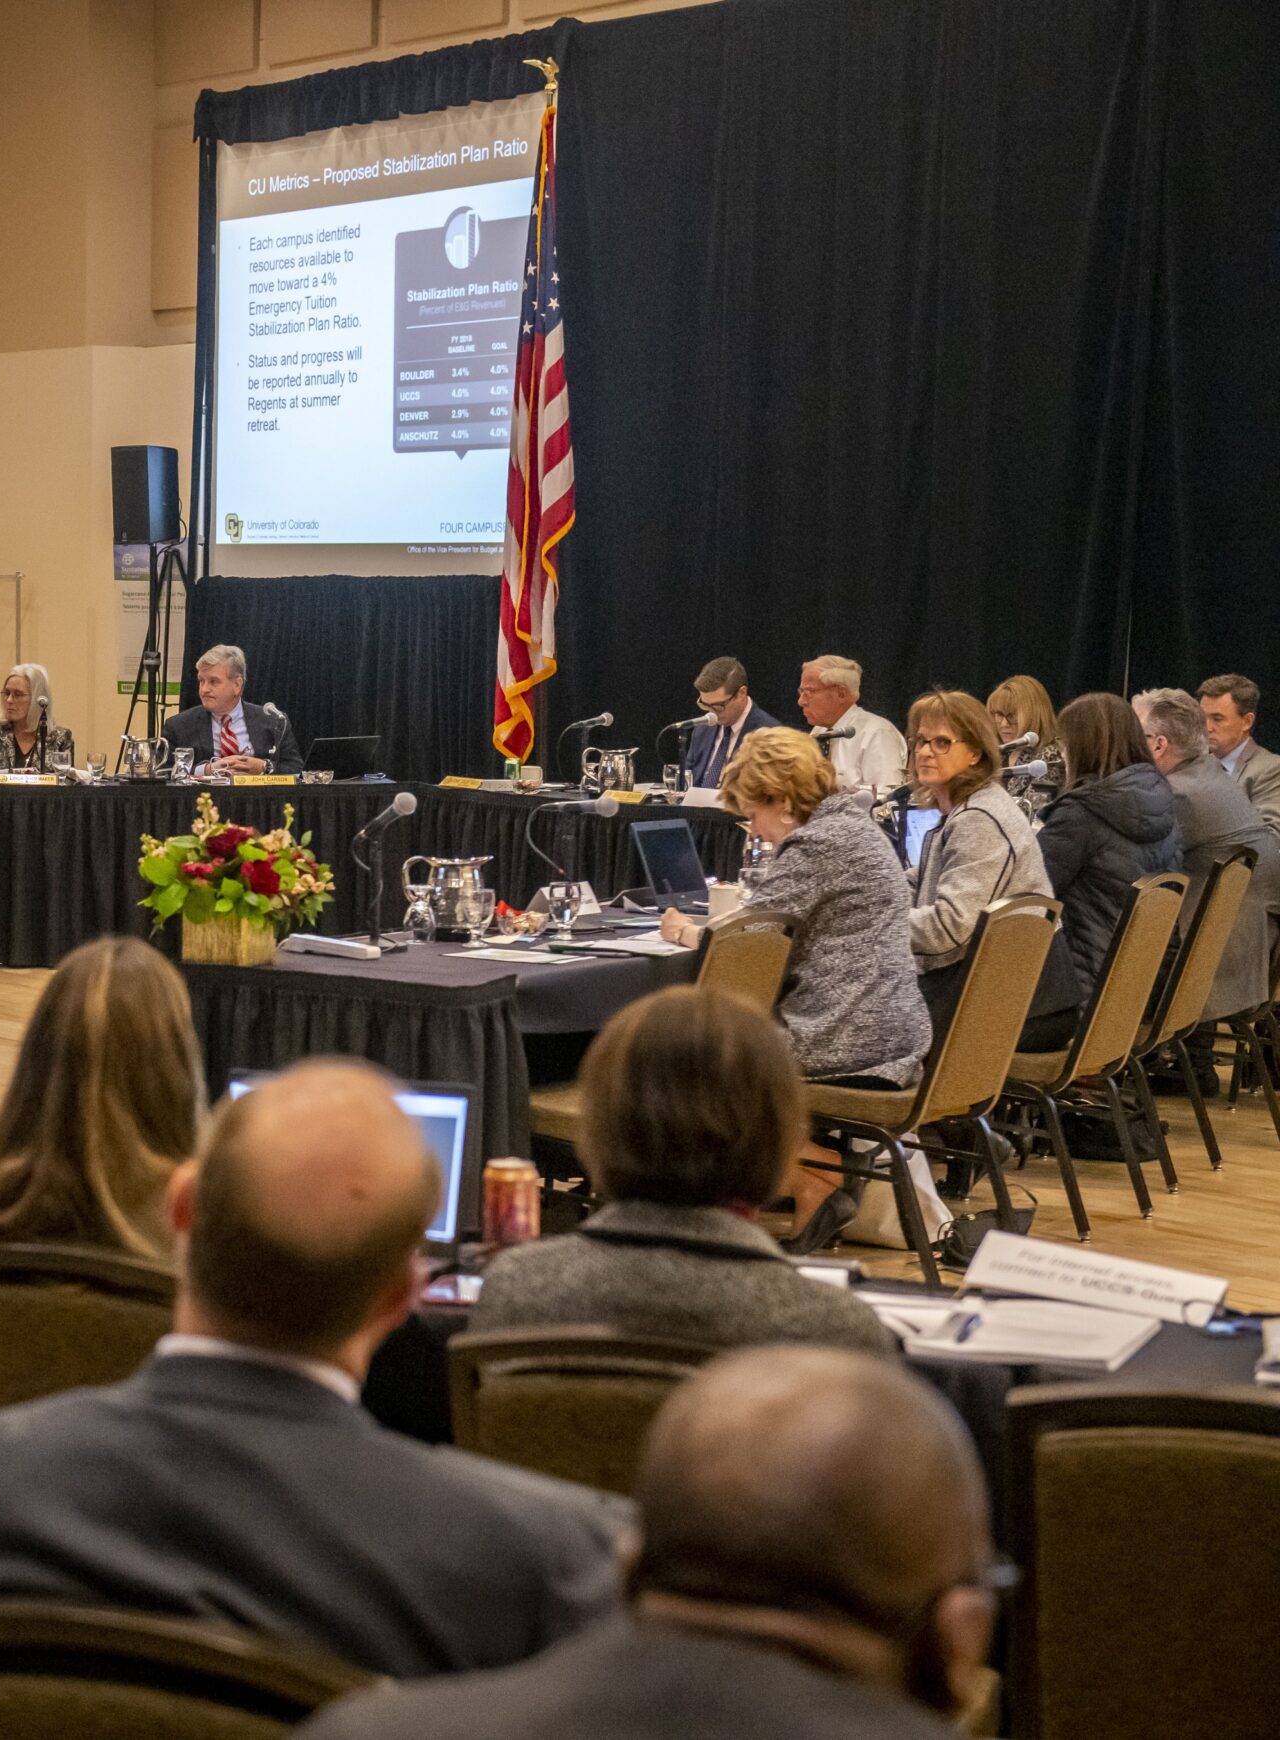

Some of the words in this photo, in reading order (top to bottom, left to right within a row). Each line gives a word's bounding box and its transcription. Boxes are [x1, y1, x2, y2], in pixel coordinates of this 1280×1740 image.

[248, 177, 266, 196] CU
[269, 173, 310, 193] Metrics
[323, 161, 380, 186] Proposed
[383, 150, 457, 176] Stabilization
[461, 145, 490, 164] Plan
[493, 138, 528, 159] Ratio
[249, 236, 273, 251] Each
[276, 233, 314, 249] campus
[316, 224, 361, 243] identified
[249, 257, 295, 273] resources
[298, 250, 341, 268] available
[344, 249, 354, 262] to
[249, 281, 274, 294] move
[277, 275, 309, 292] toward
[312, 277, 318, 288] a
[321, 272, 337, 287] 4%
[407, 286, 465, 302] Stabilization
[468, 283, 489, 296] Plan
[492, 280, 519, 293] Ratio
[249, 299, 302, 317] Emergency
[304, 294, 337, 310] Tuition
[249, 319, 305, 337] Stabilization
[308, 316, 330, 332] Plan
[333, 313, 362, 329] Ratio.
[448, 344, 475, 354] BASELINE
[491, 342, 508, 350] GOAL
[248, 354, 278, 368] Status
[280, 351, 299, 366] and
[301, 350, 343, 368] progress
[346, 345, 362, 361] will
[248, 376, 260, 390] be
[262, 372, 302, 391] reported
[304, 370, 345, 388] annually
[348, 369, 358, 383] to
[400, 370, 435, 381] BOULDER
[490, 365, 509, 374] 4.0%
[400, 391, 420, 401] UCCS
[490, 385, 508, 395] 4.0%
[248, 396, 287, 413] Regents
[289, 395, 299, 409] at
[301, 395, 341, 408] summer
[400, 411, 429, 421] DENVER
[451, 409, 469, 419] 2.9%
[490, 407, 508, 416] 4.0%
[247, 418, 280, 432] retreat.
[400, 431, 439, 441] ANSCHUTZ
[451, 430, 469, 439] 4.0%
[490, 428, 508, 437] 4.0%
[247, 520, 278, 532] University
[280, 520, 287, 530] of
[288, 519, 319, 530] Colorado
[440, 522, 464, 533] FOUR
